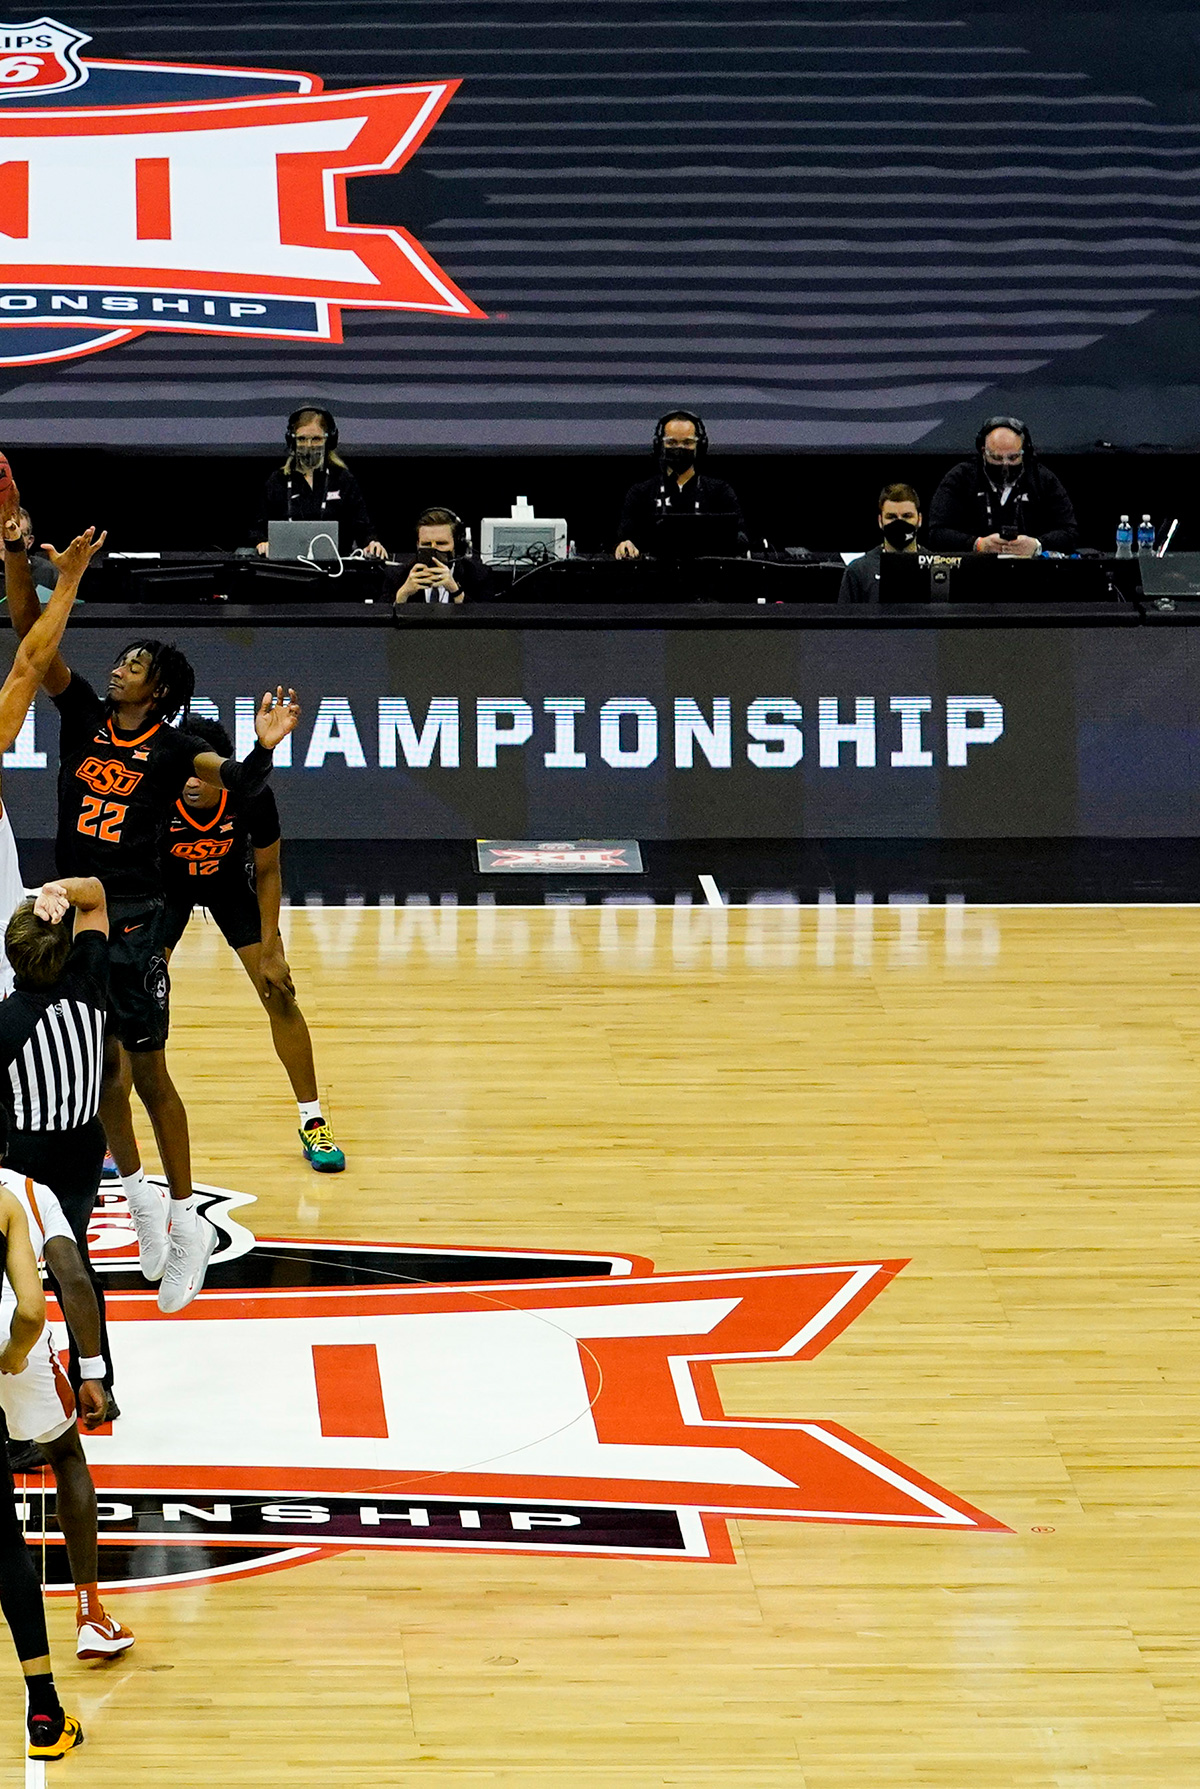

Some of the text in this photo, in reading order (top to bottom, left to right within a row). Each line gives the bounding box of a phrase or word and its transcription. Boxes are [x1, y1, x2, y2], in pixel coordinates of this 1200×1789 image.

[74, 756, 144, 797] OSU
[77, 795, 130, 844] 22
[170, 838, 235, 861] OSU
[188, 859, 220, 876] 12
